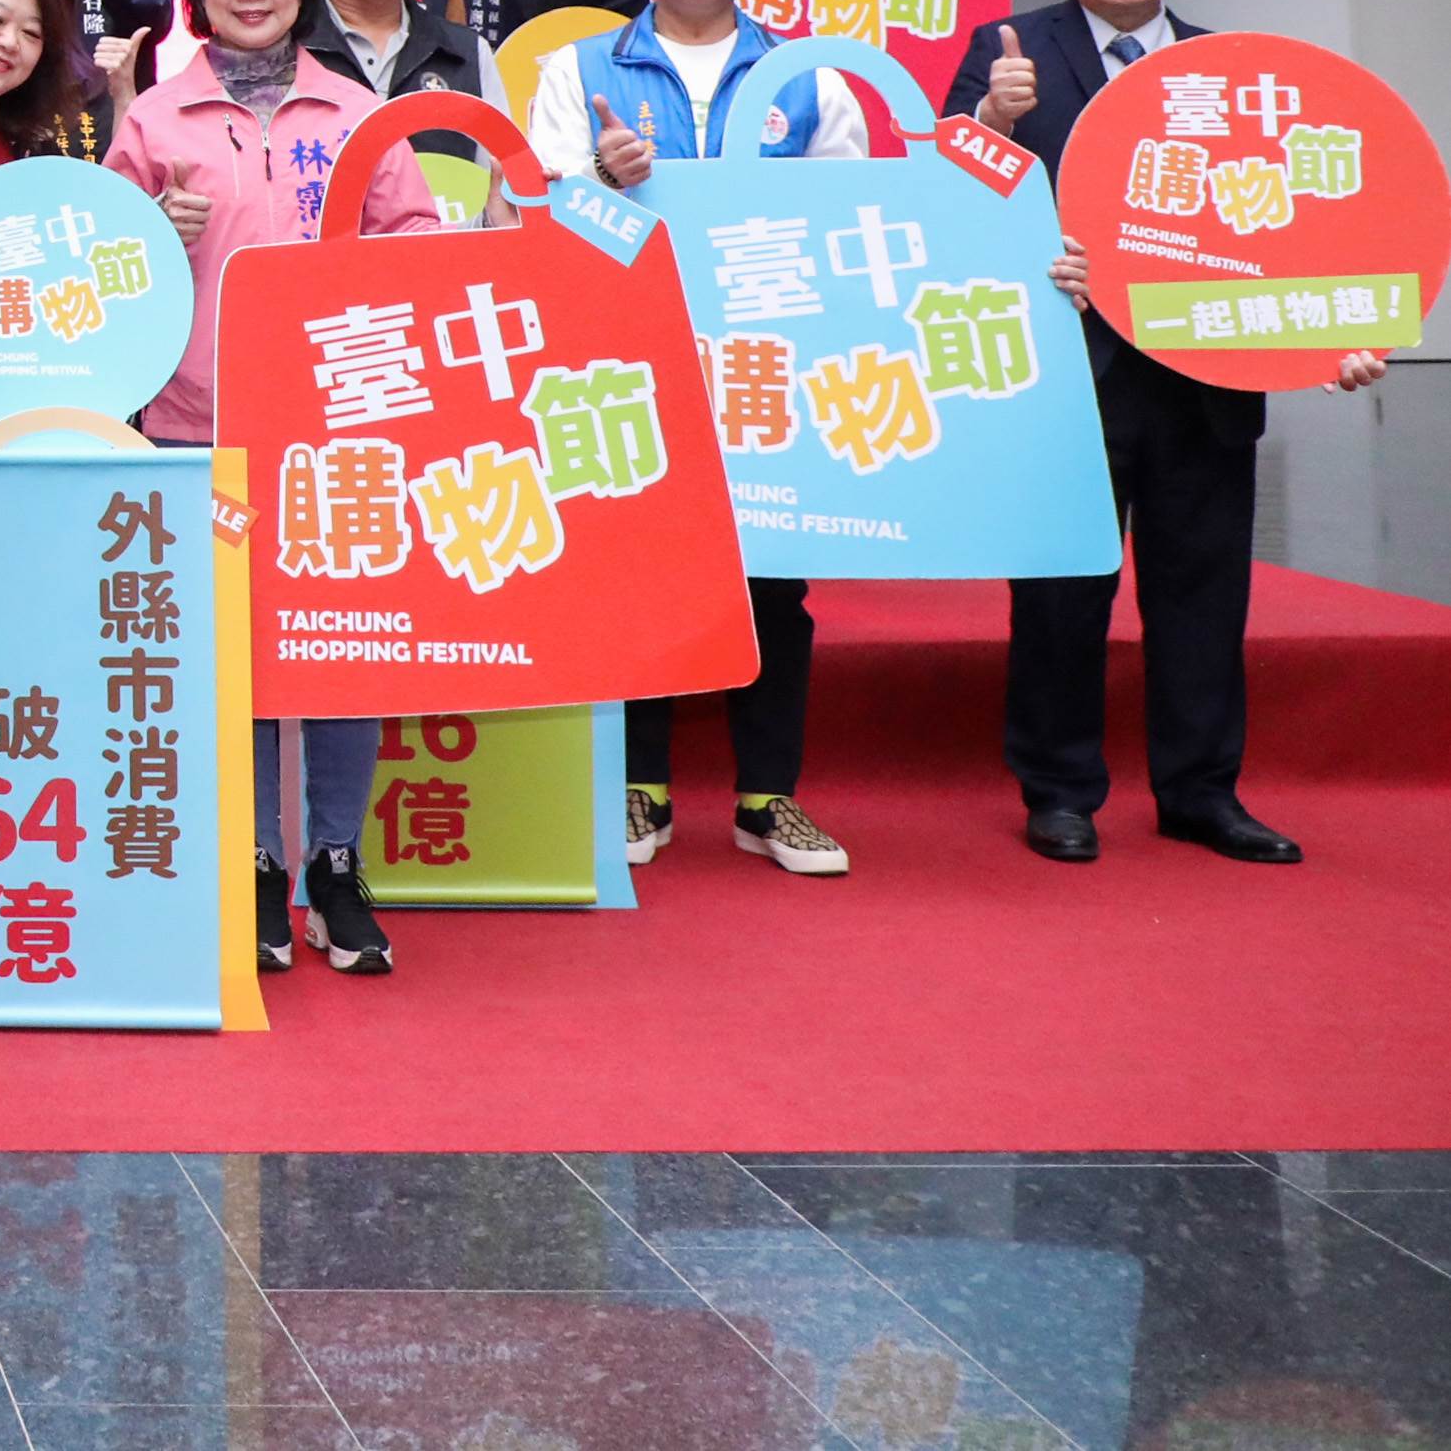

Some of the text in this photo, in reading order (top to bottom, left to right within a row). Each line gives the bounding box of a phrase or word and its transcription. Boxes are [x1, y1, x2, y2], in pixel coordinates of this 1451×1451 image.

[1161, 72, 1300, 137] 臺中
[949, 127, 1023, 181] SALE
[1125, 123, 1363, 236] 購物節
[564, 187, 644, 245] SALE
[1119, 222, 1198, 248] TAICHUNG
[706, 205, 928, 325] 臺中
[1117, 238, 1264, 277] SHOPPING FESTIVAL
[1145, 285, 1402, 341] 一起購物趣!
[303, 283, 545, 430] 臺中
[697, 279, 1041, 477] 購物節
[276, 358, 670, 595] 購物節
[727, 481, 798, 506] HUNG
[211, 500, 248, 533] ALE
[801, 514, 909, 541] FESTIVAL
[276, 609, 413, 635] TAICHUNG
[277, 640, 533, 666] SHOPPING FESTIVAL
[96, 490, 181, 880] 外縣市消費
